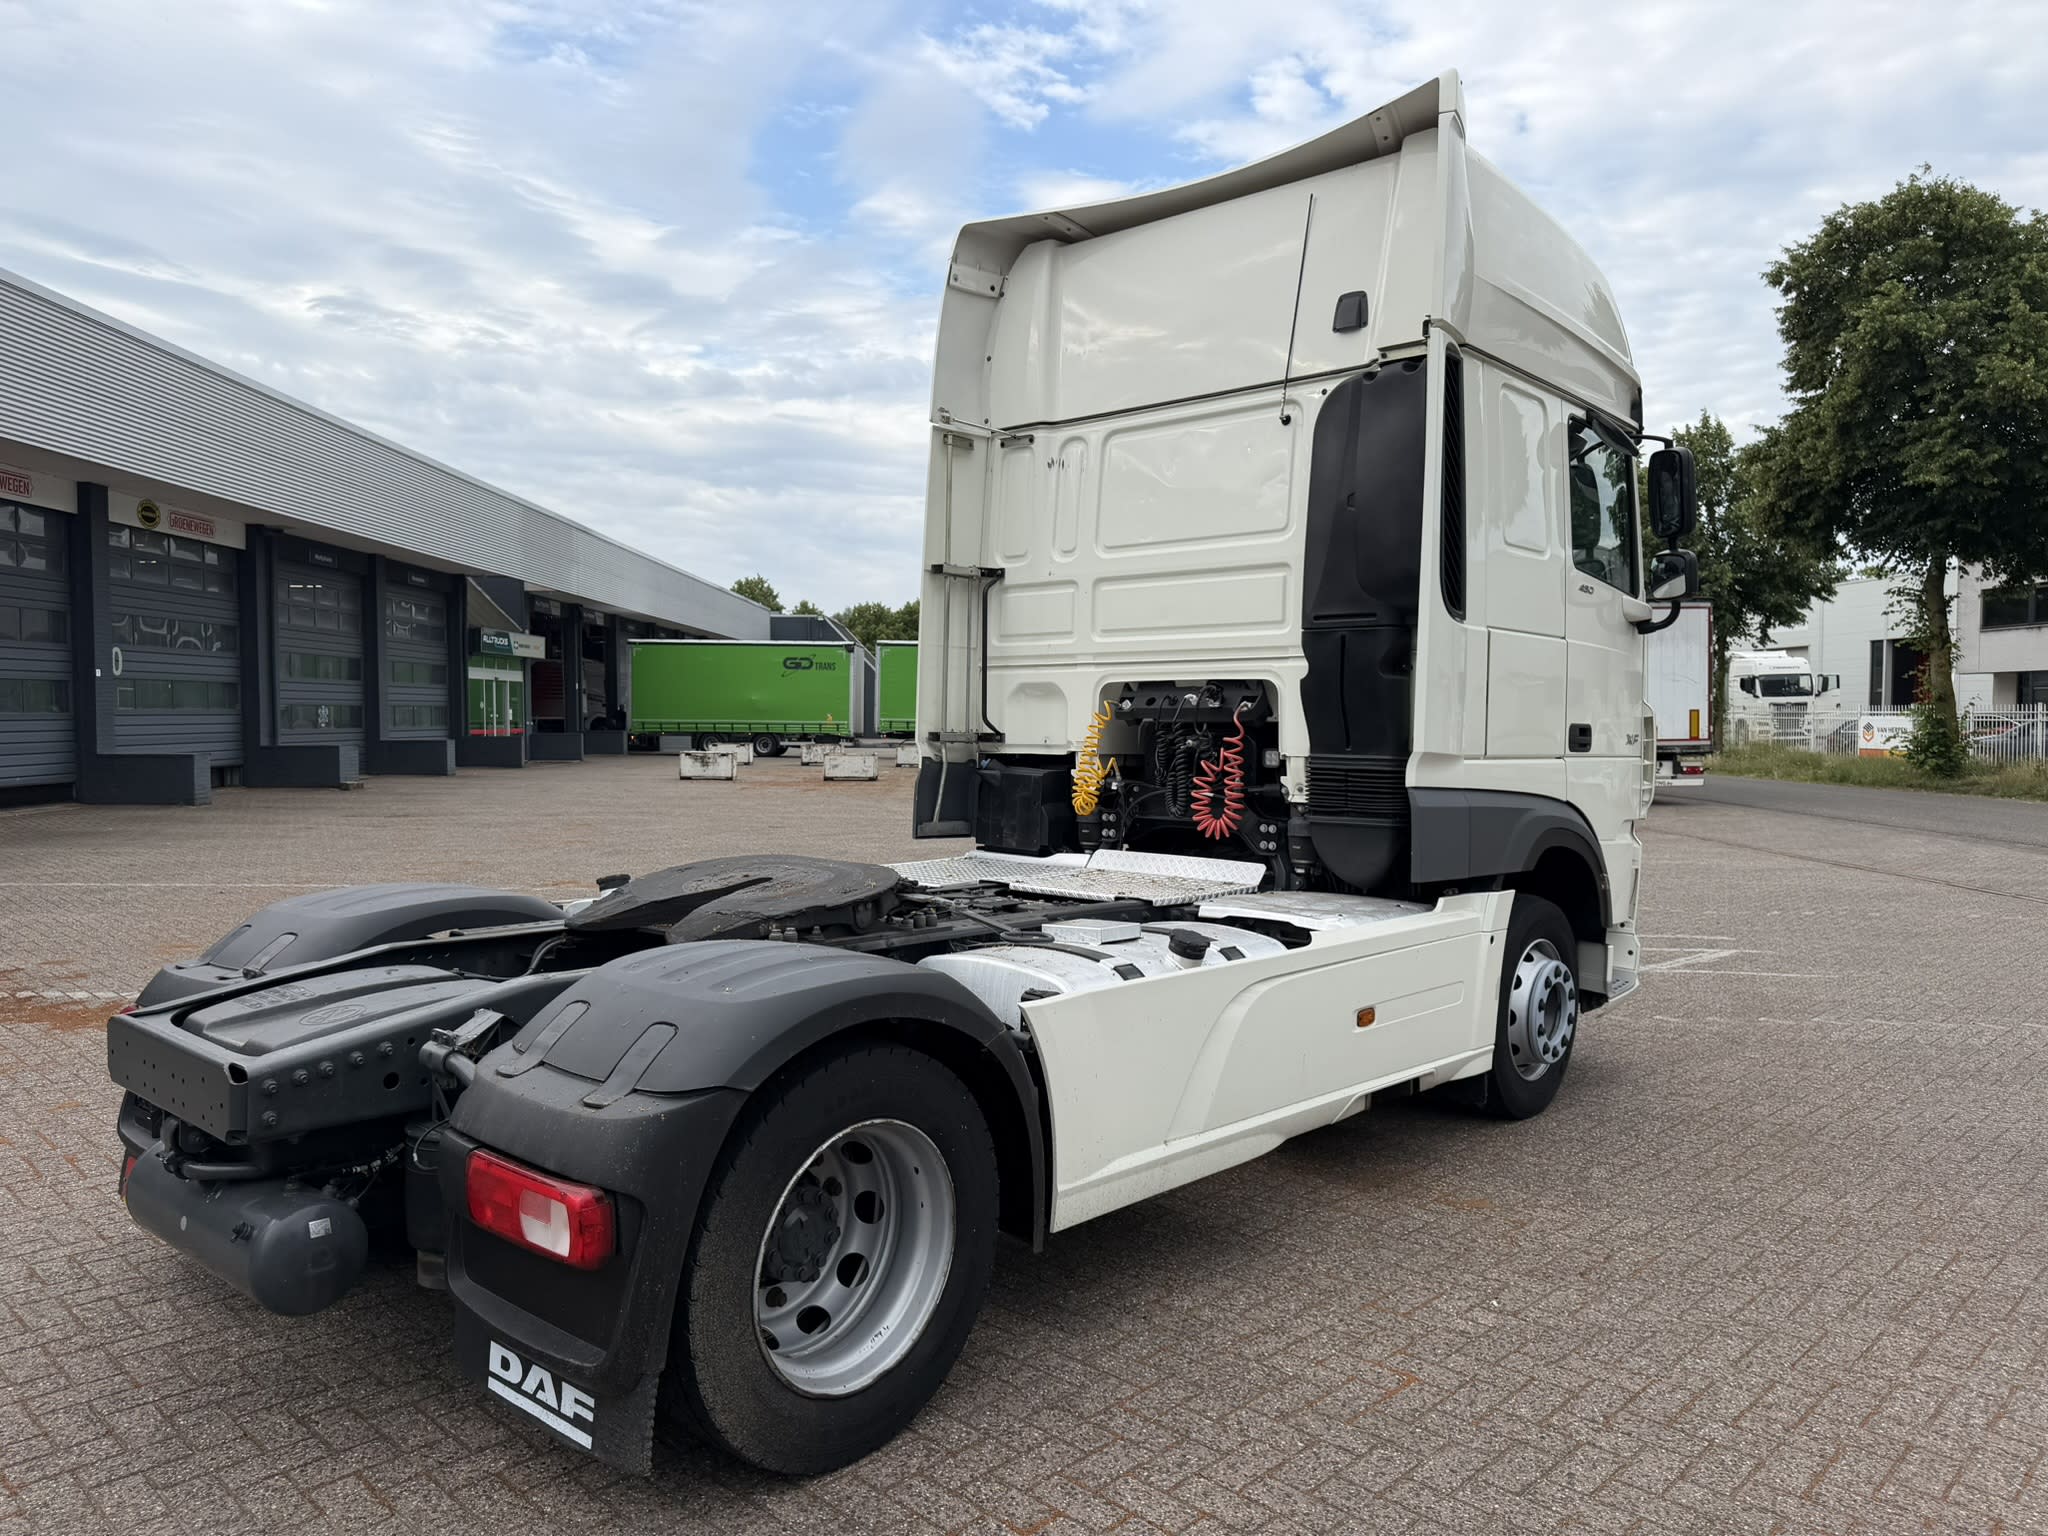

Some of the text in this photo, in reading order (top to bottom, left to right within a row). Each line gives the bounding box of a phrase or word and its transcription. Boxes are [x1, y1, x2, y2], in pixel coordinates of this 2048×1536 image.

[170, 512, 214, 536] GROENEWEGEN
[815, 661, 836, 671] TRANS
[1625, 733, 1639, 745] XF
[489, 1340, 595, 1423] DAF
